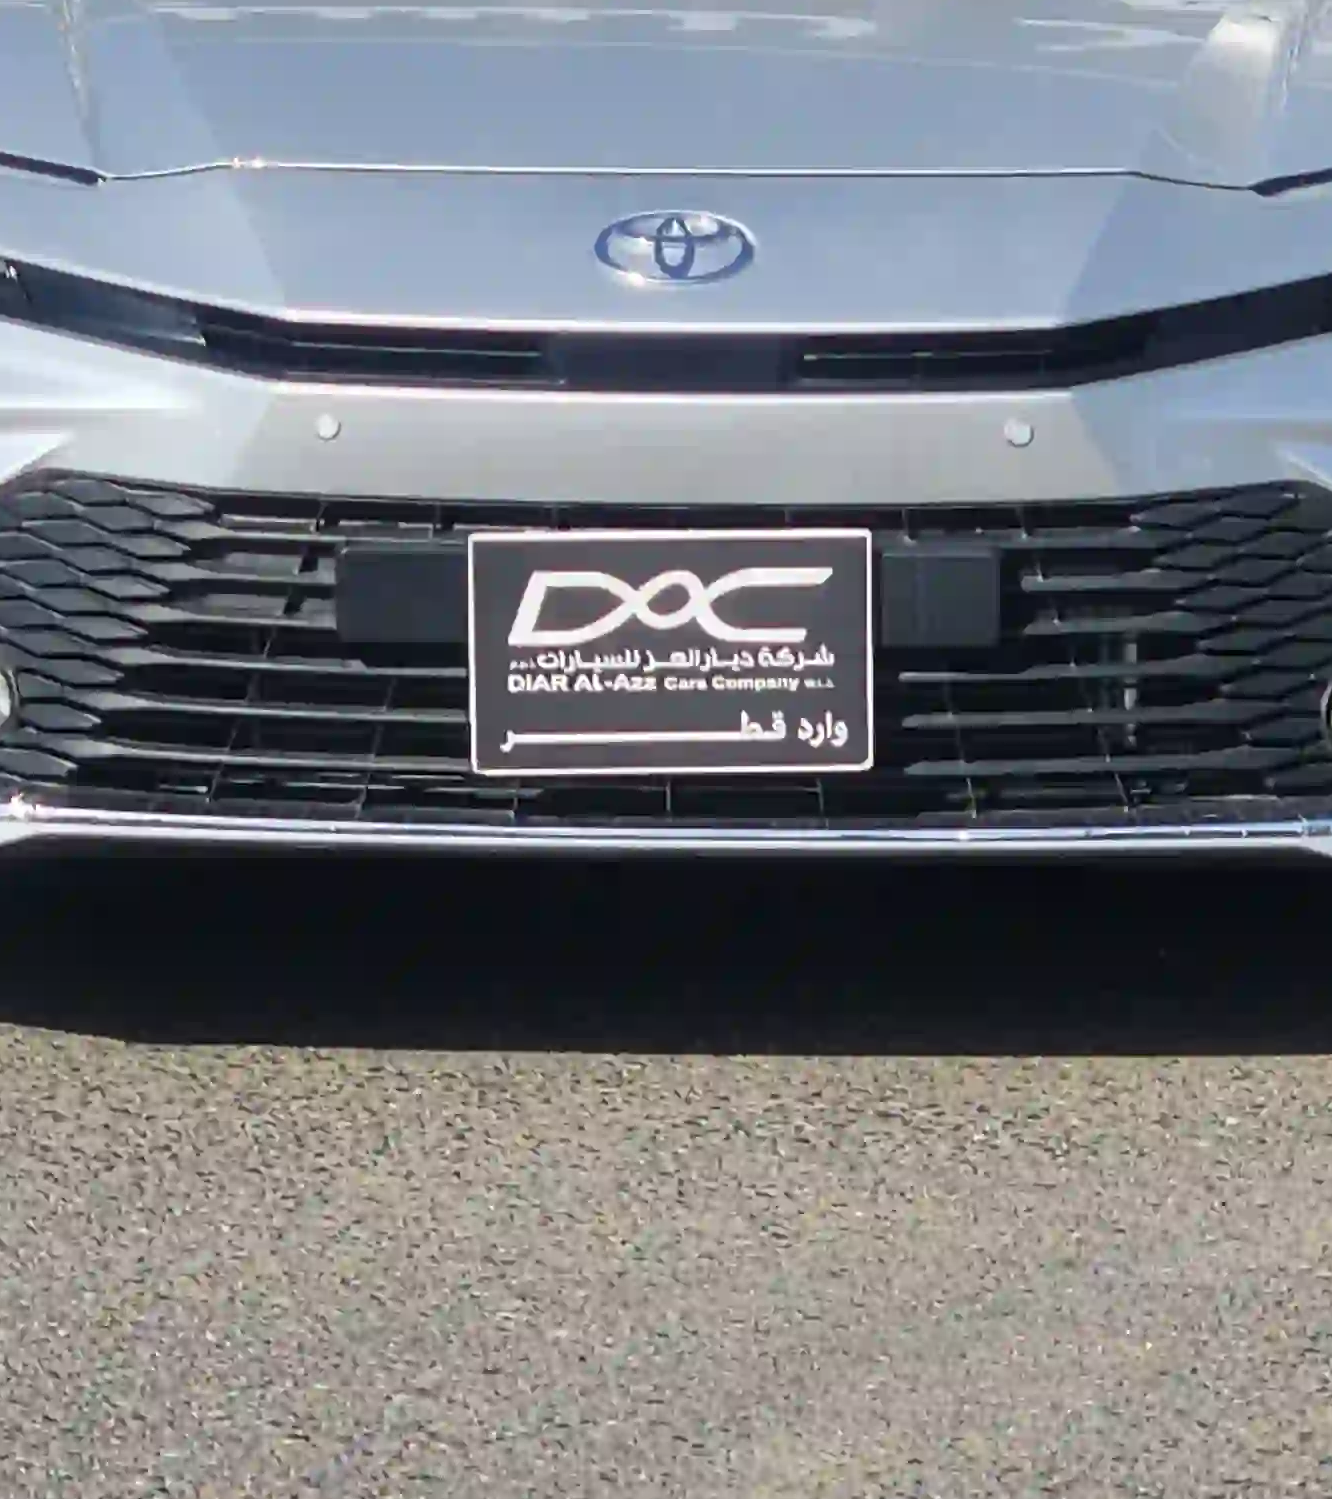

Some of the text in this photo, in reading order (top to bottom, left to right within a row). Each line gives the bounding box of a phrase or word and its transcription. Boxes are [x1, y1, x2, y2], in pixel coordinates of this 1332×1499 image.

[758, 643, 835, 671] شركة
[507, 673, 569, 693] DIAR
[712, 674, 800, 692] Company
[798, 710, 848, 748] وارد
